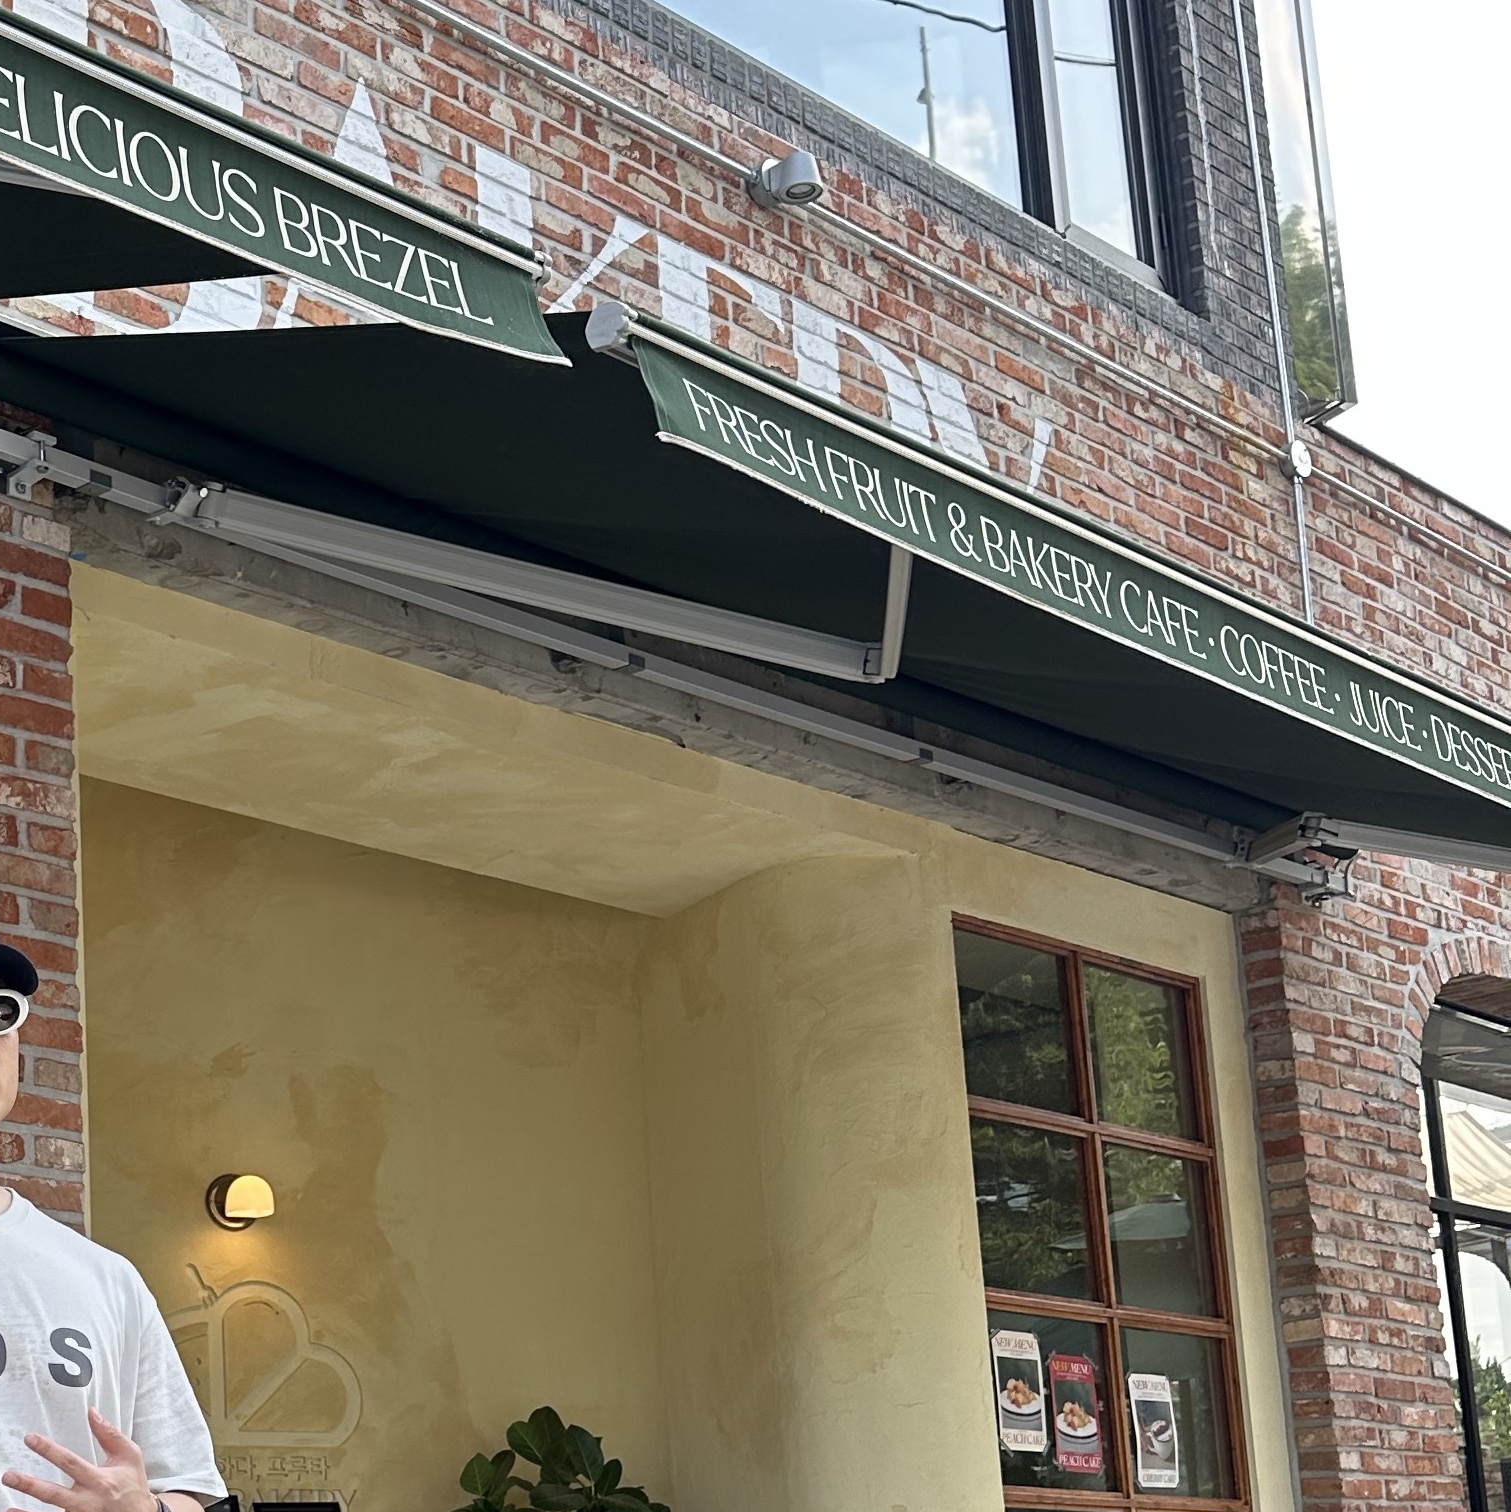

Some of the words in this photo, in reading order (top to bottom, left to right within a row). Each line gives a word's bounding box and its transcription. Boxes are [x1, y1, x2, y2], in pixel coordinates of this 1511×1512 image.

[272, 186, 494, 326] BREZEL
[682, 377, 827, 492] FRESH
[824, 446, 936, 542] FRUIT
[947, 502, 982, 563] &
[979, 515, 1112, 618] BAKERY
[1119, 580, 1207, 659] CAFE
[1220, 625, 1335, 714] COFFEE
[1349, 681, 1422, 752] JUICE
[1052, 1360, 1069, 1372] NEW
[1069, 1362, 1091, 1375] MENU
[267, 1455, 330, 1482] 프루타
